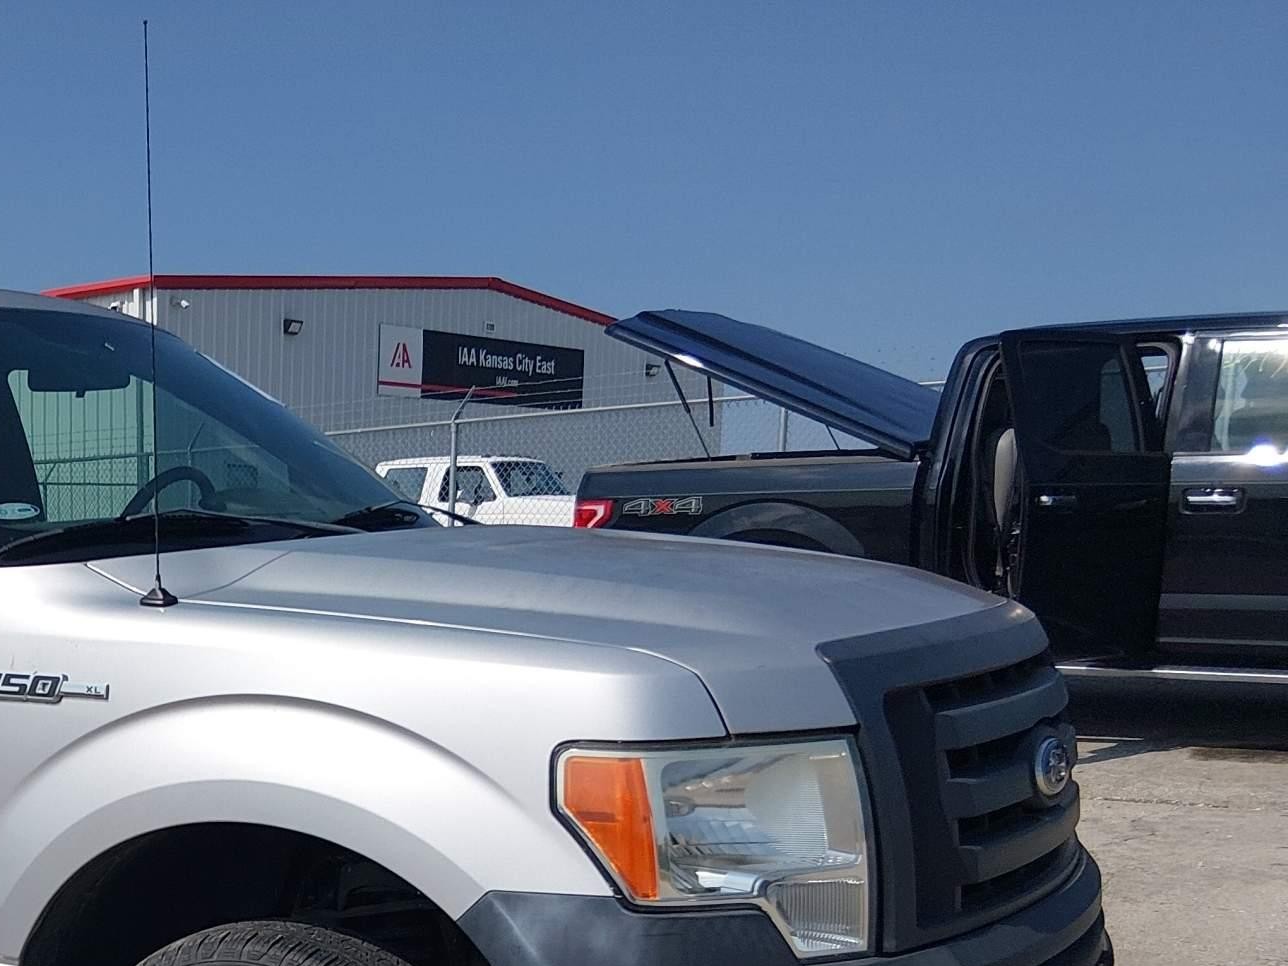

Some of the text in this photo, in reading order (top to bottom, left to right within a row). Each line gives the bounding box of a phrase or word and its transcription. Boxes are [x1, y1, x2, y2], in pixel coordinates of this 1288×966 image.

[458, 346, 555, 376] IAA Kansas City East
[86, 685, 102, 694] XL
